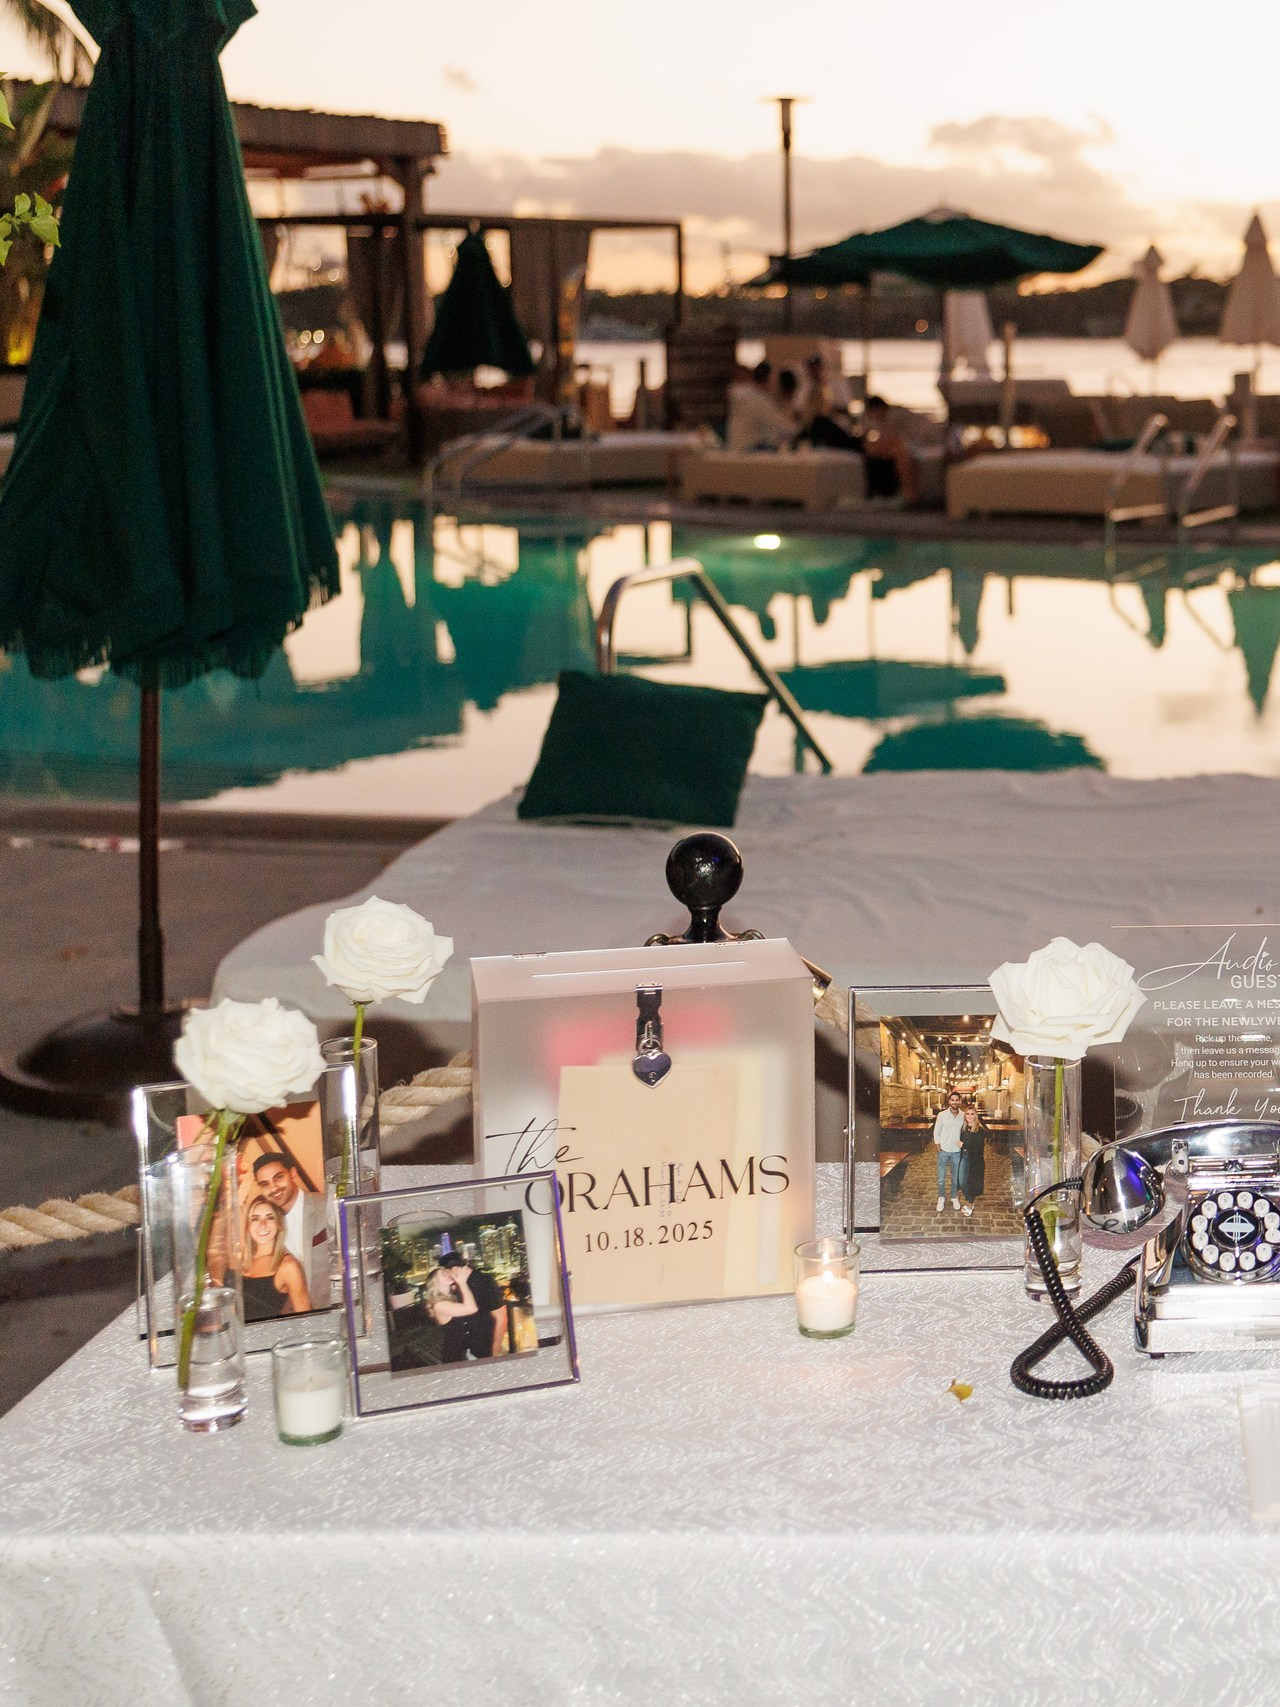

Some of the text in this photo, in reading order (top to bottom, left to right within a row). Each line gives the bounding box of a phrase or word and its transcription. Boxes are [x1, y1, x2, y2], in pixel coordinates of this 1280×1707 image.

[1136, 932, 1279, 990] Audio
[1153, 1000, 1201, 1010] PLEASE
[1203, 999, 1243, 1010] LEAVE
[1245, 999, 1254, 1009] A
[1167, 1017, 1192, 1027] FOR
[1194, 1017, 1219, 1027] THE
[1195, 1034, 1214, 1043] Pick
[1215, 1035, 1227, 1044] up
[1228, 1034, 1241, 1043] the
[1180, 1046, 1200, 1054] then
[1201, 1046, 1224, 1054] leave
[1171, 1058, 1194, 1068] Hang
[1195, 1060, 1207, 1068] up
[1208, 1059, 1218, 1067] to
[1219, 1059, 1249, 1067] ensure
[1250, 1059, 1269, 1068] your
[1193, 1069, 1275, 1079] has been recorded.
[1173, 1088, 1241, 1120] Thank
[485, 1117, 584, 1190] the
[584, 1220, 714, 1253] 10.18.2025
